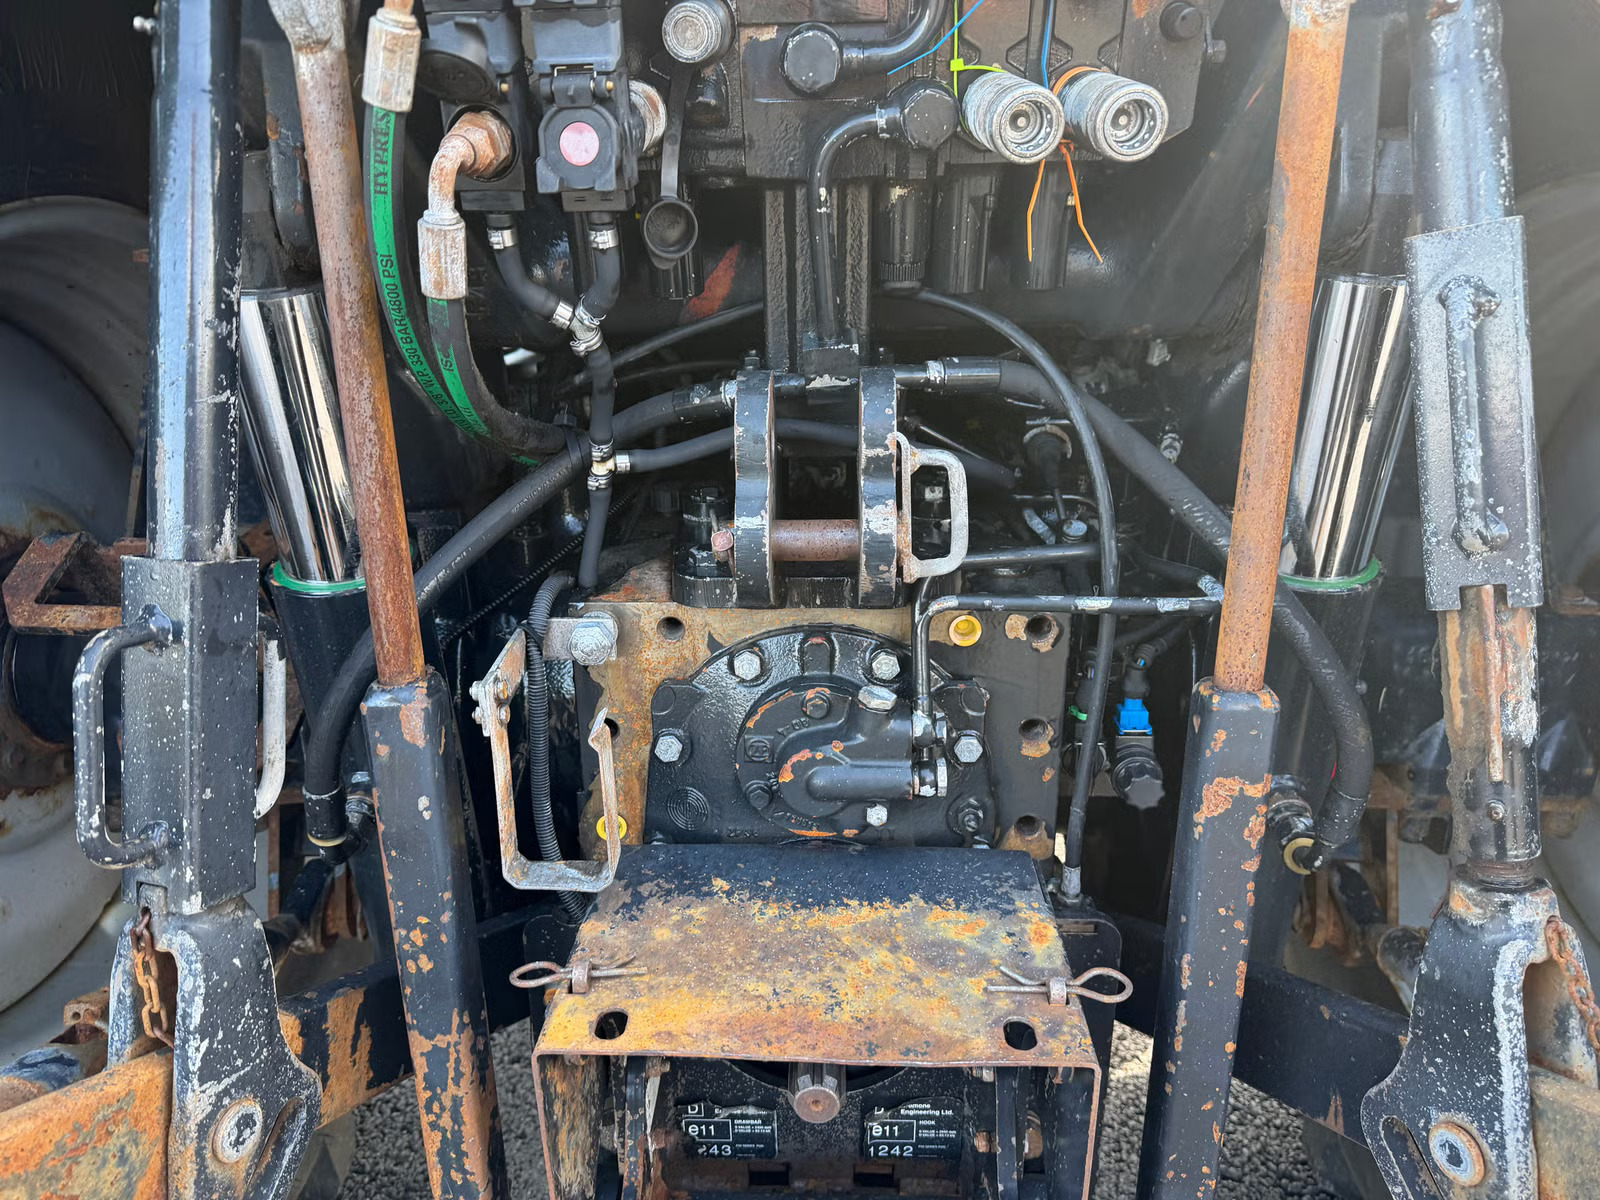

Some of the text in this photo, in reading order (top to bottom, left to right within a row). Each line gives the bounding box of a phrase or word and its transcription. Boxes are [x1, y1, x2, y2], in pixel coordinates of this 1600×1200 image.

[379, 254, 396, 279] PSI
[385, 283, 414, 345] BAR/4800
[405, 347, 424, 367] 330
[688, 1124, 715, 1136] e11
[872, 1125, 899, 1137] e11
[868, 1145, 914, 1157] 1242
